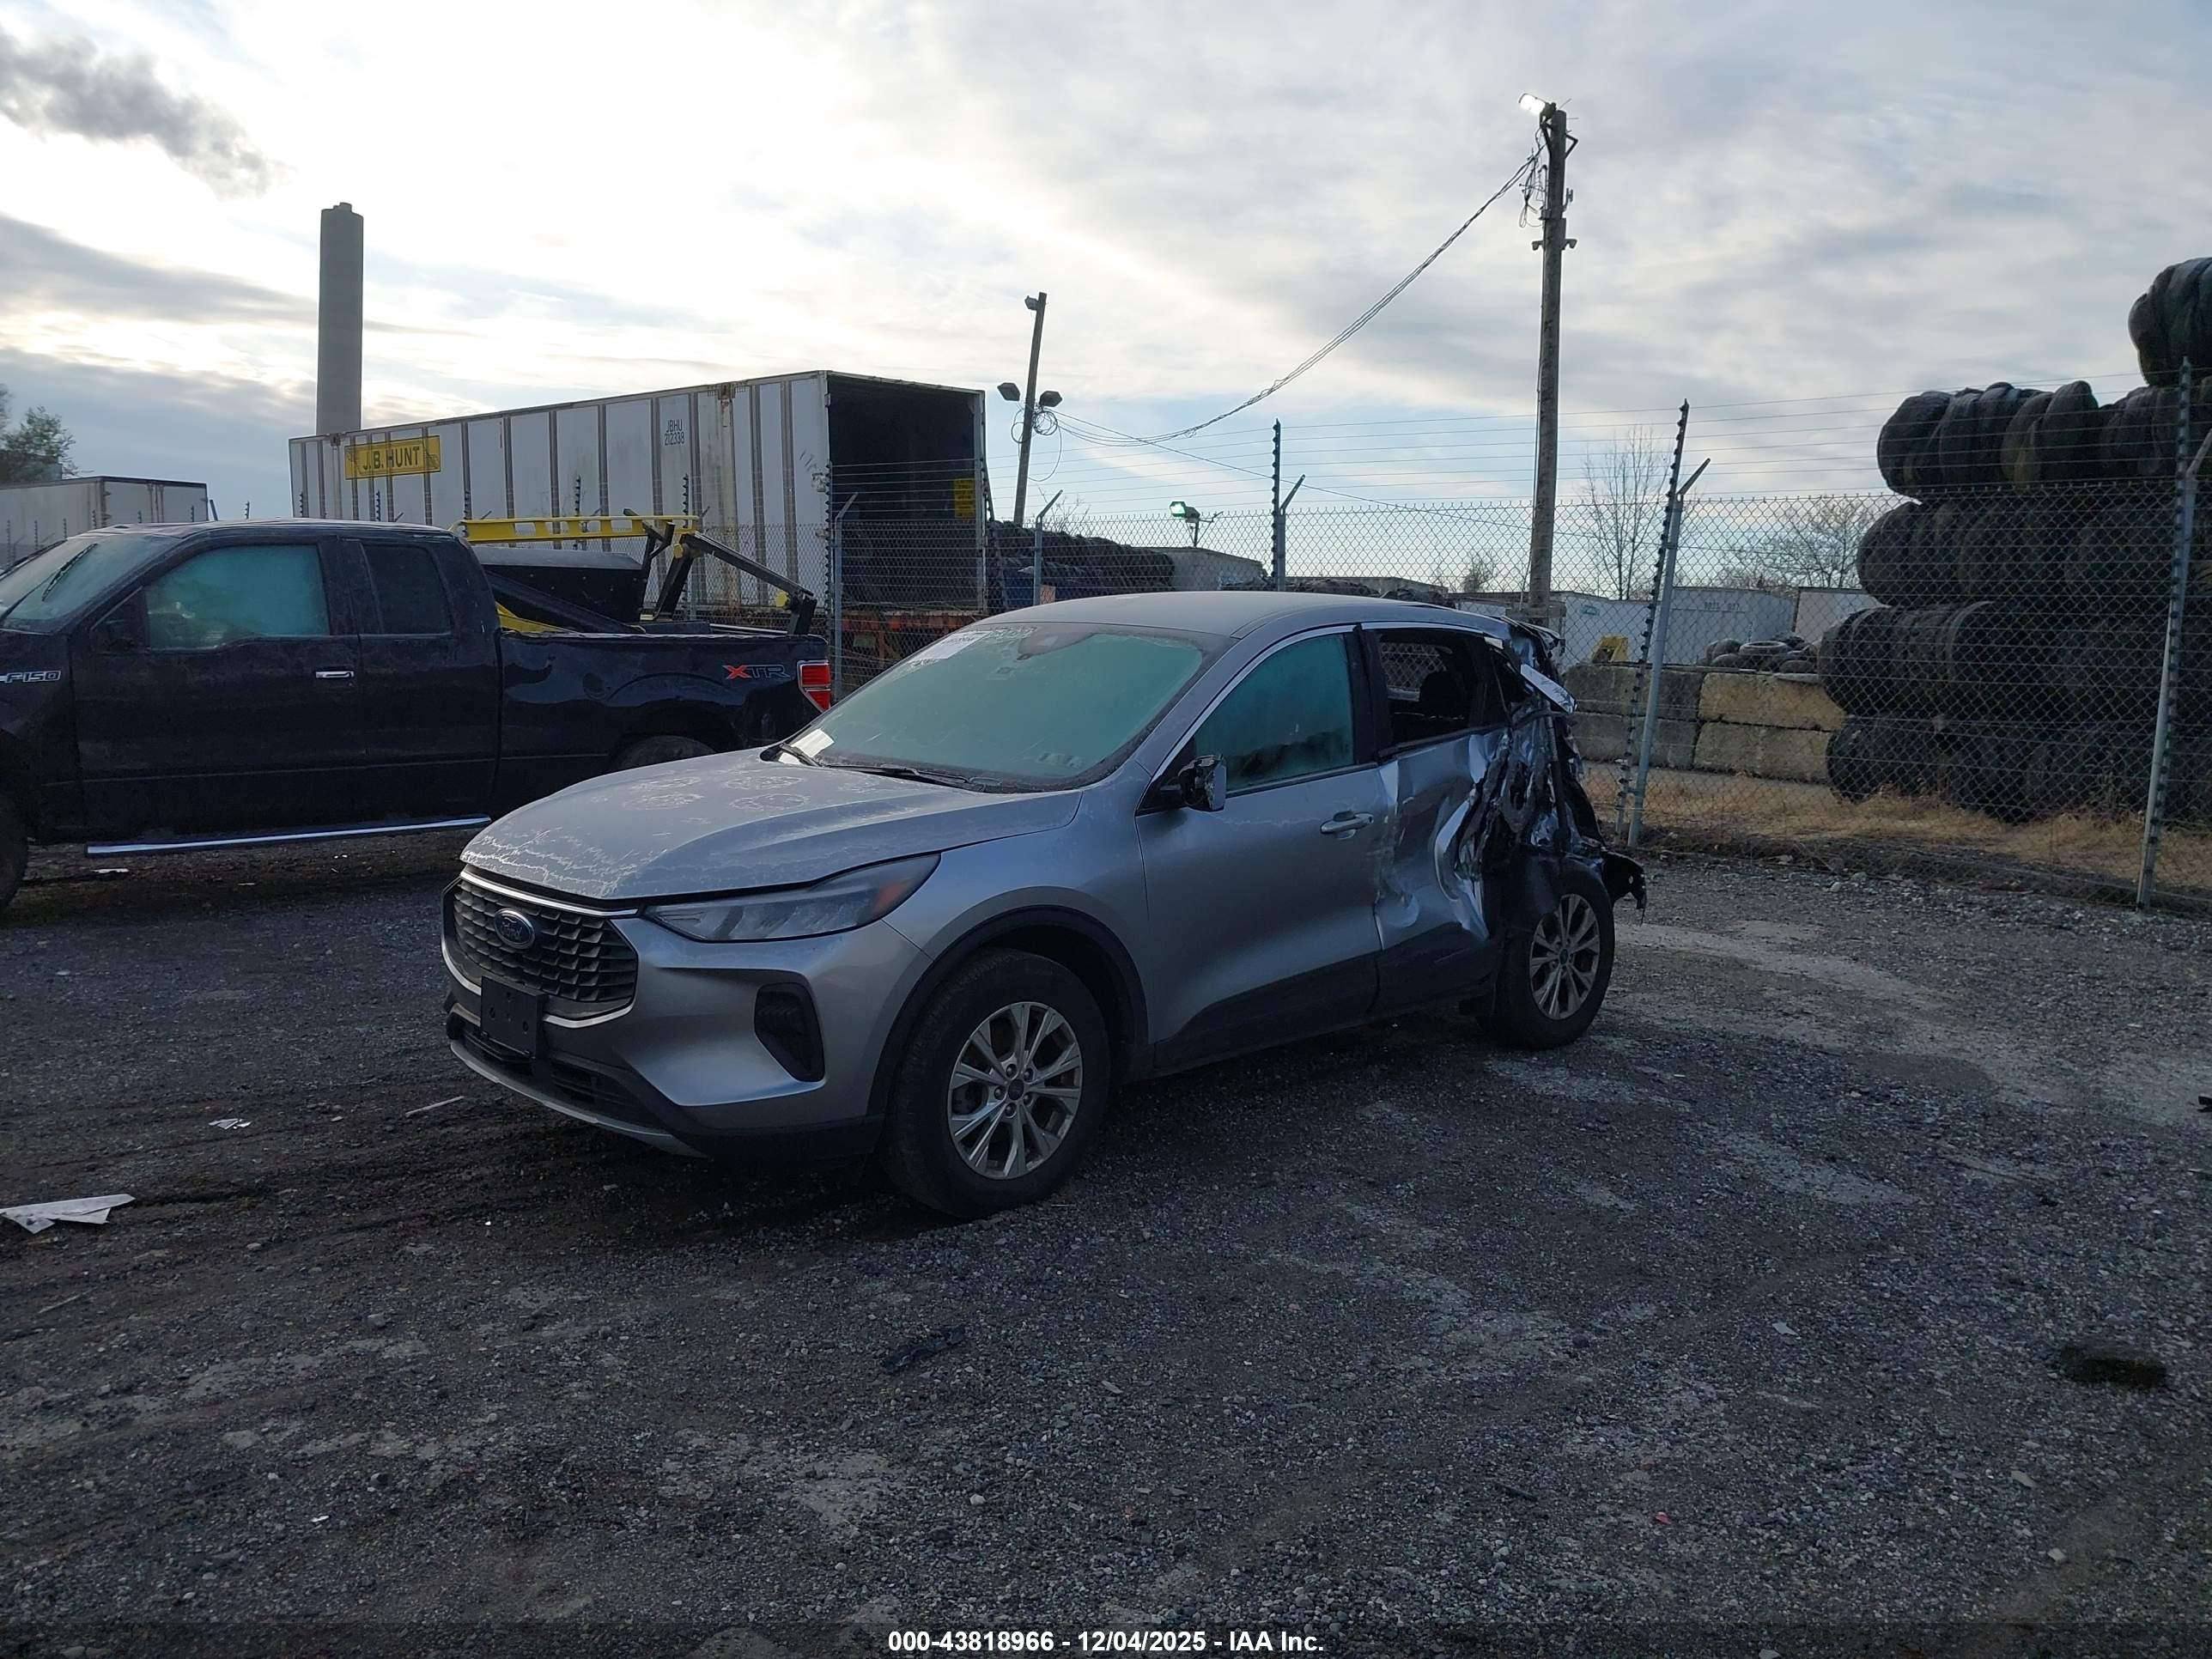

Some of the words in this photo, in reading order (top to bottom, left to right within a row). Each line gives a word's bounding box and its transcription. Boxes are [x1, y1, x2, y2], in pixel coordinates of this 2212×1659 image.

[665, 418, 683, 433] JBHU
[362, 450, 384, 471] J.B.
[386, 446, 420, 468] HUNT
[721, 664, 790, 679] XTR
